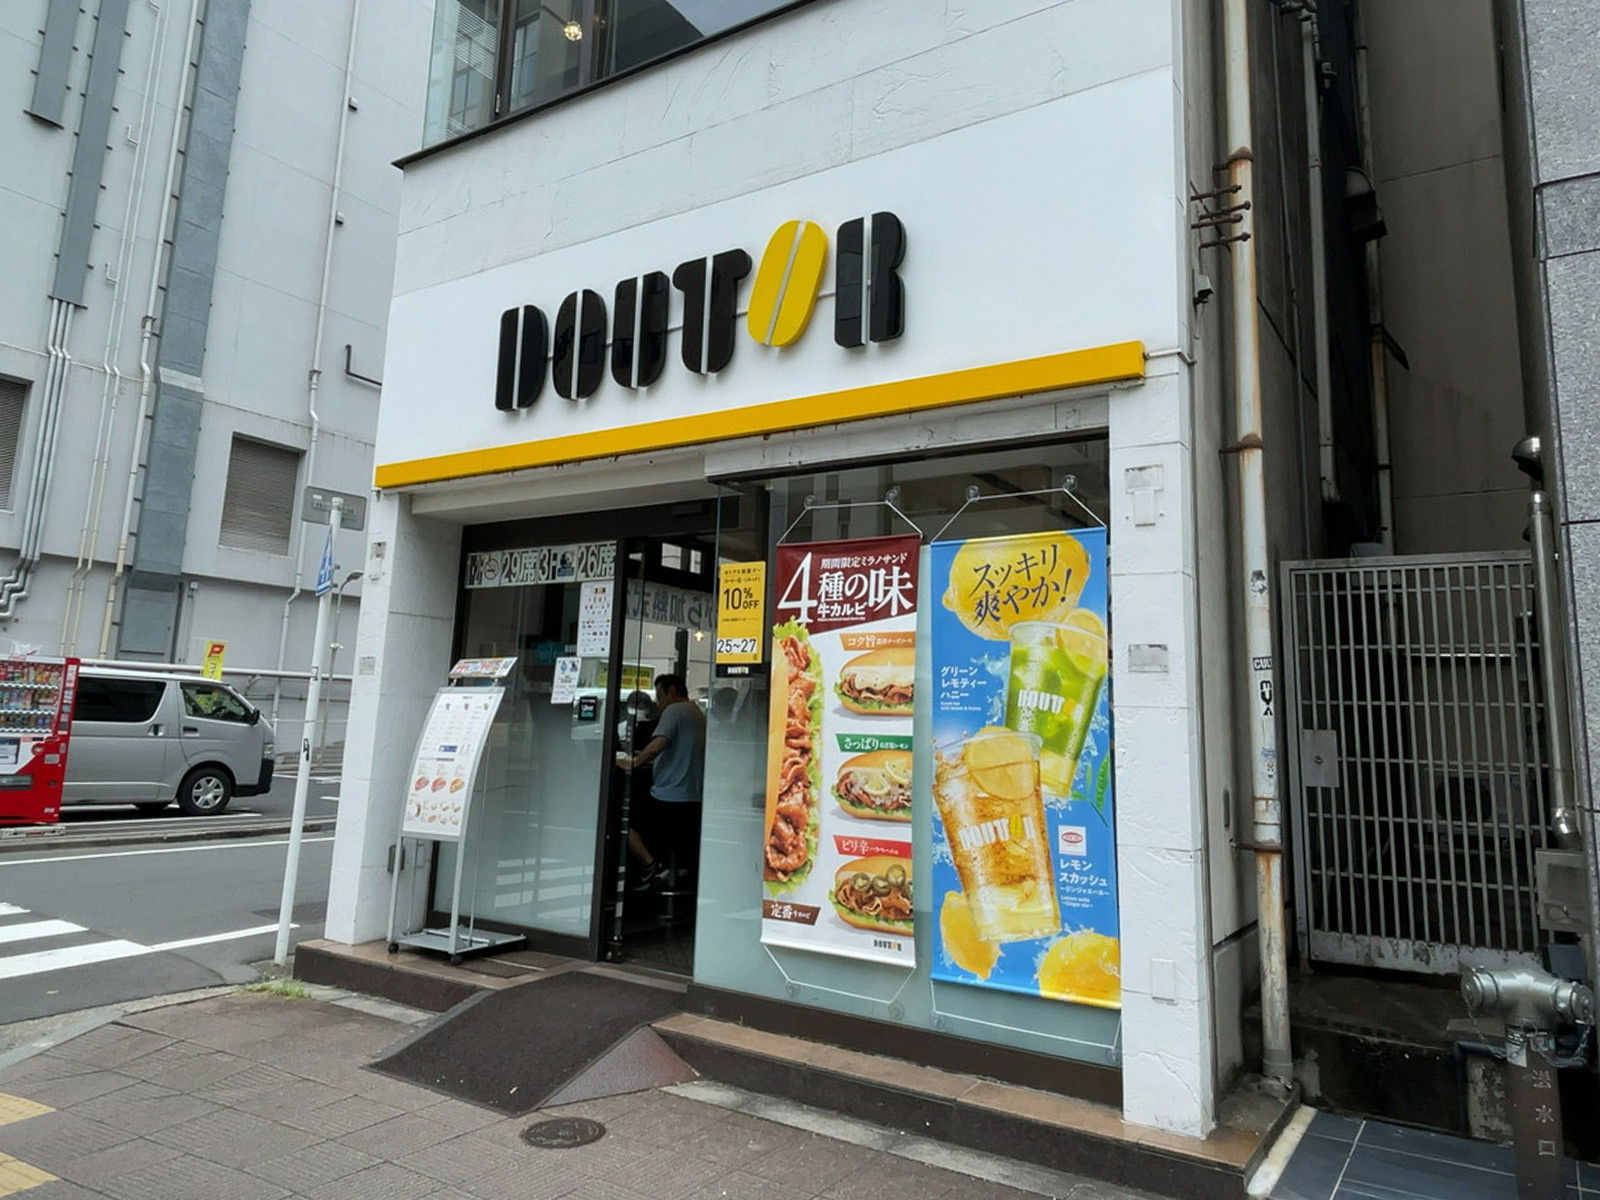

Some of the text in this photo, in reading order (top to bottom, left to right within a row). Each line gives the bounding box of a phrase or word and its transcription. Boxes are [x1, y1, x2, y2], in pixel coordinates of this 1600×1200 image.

[495, 212, 906, 412] DOUTOR
[502, 551, 538, 583] 29席
[577, 545, 615, 578] 26席
[820, 552, 908, 570] 期間限定ミラノサンド
[968, 544, 1058, 598] スッキリ
[743, 600, 759, 609] OFF
[817, 602, 867, 618] 牛カルビ
[207, 644, 225, 657] P
[941, 666, 978, 677] グリーン
[941, 691, 969, 699] ハニー
[844, 737, 879, 750] さっぱり
[841, 839, 869, 854] ピリ辛
[1060, 858, 1092, 871] レモン
[1059, 872, 1108, 886] スカッシュ
[770, 903, 793, 920] 定番
